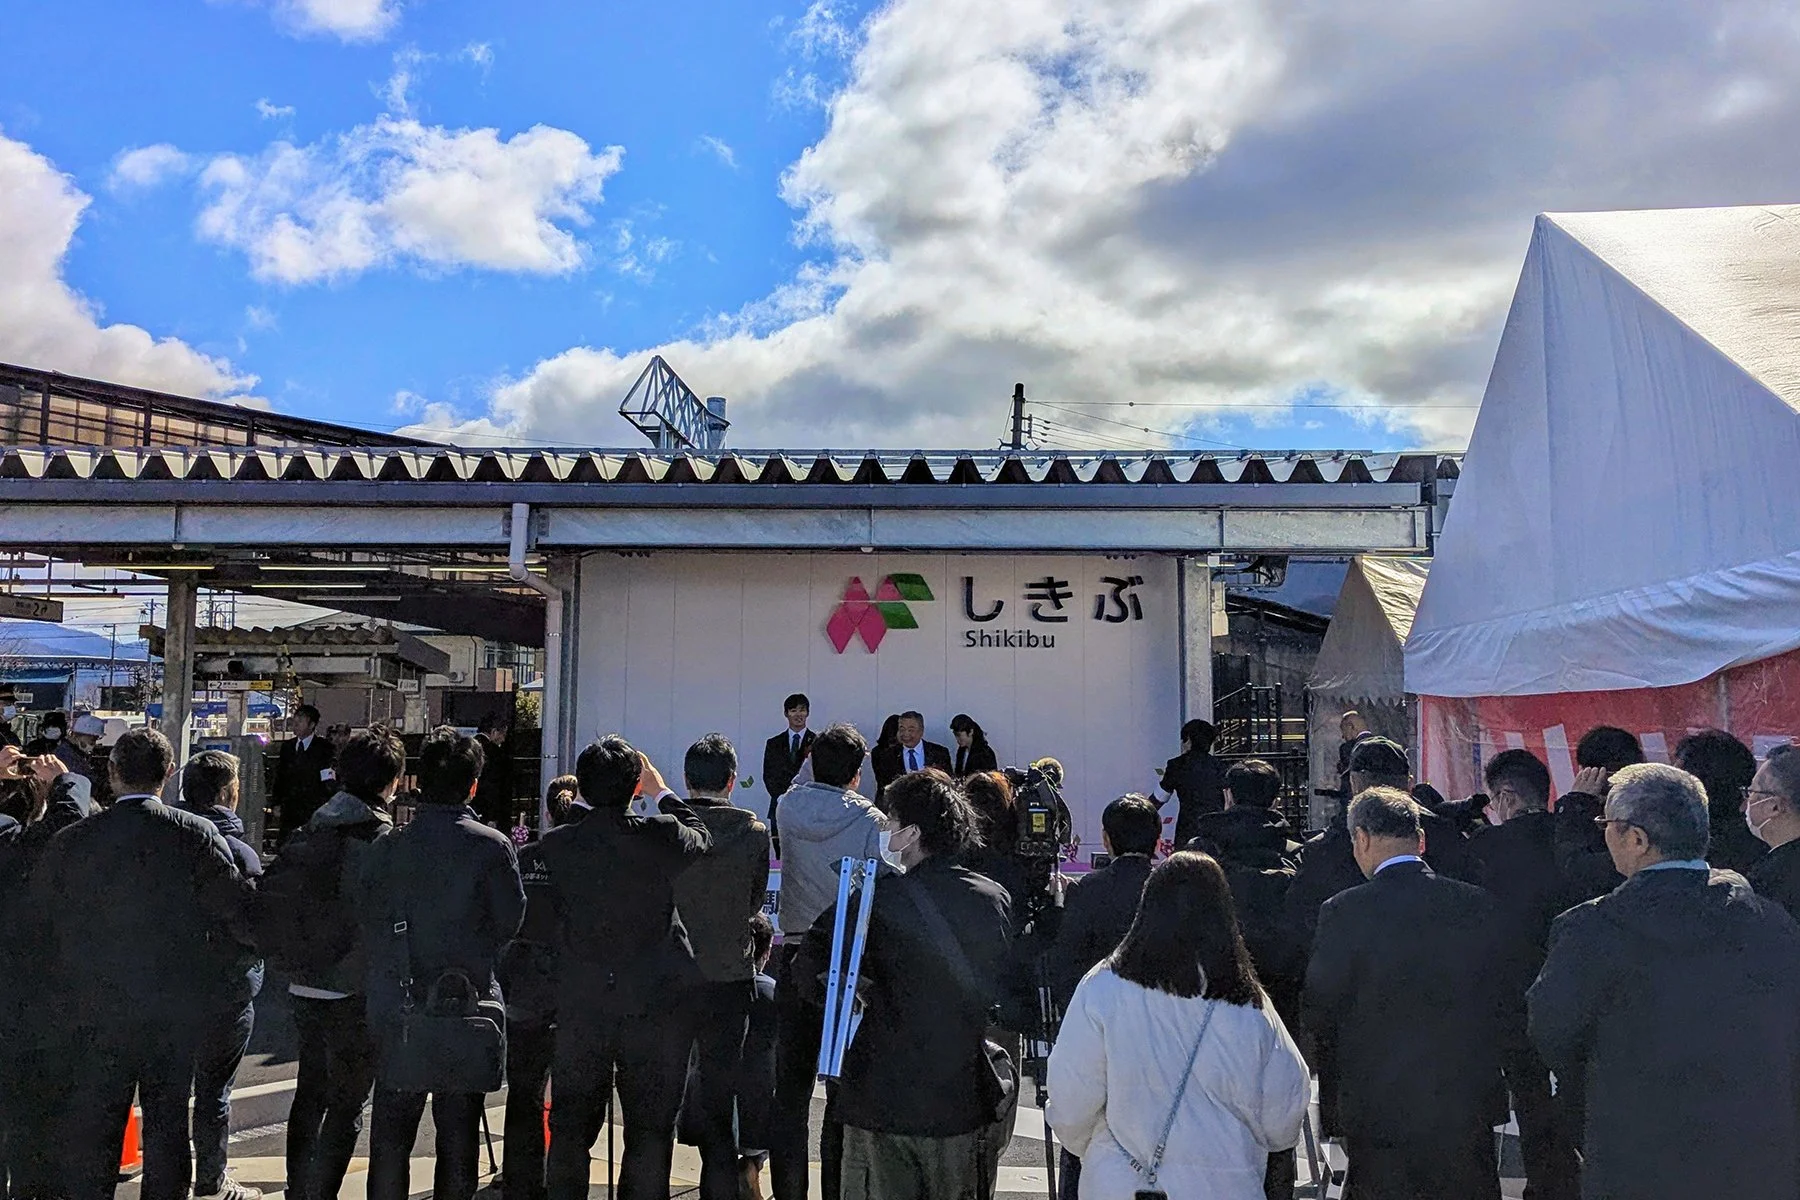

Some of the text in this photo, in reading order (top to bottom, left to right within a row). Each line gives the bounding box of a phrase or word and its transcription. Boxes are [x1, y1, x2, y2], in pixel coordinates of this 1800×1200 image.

[962, 576, 1144, 623] しきぶ
[965, 629, 1055, 648] Shikibu
